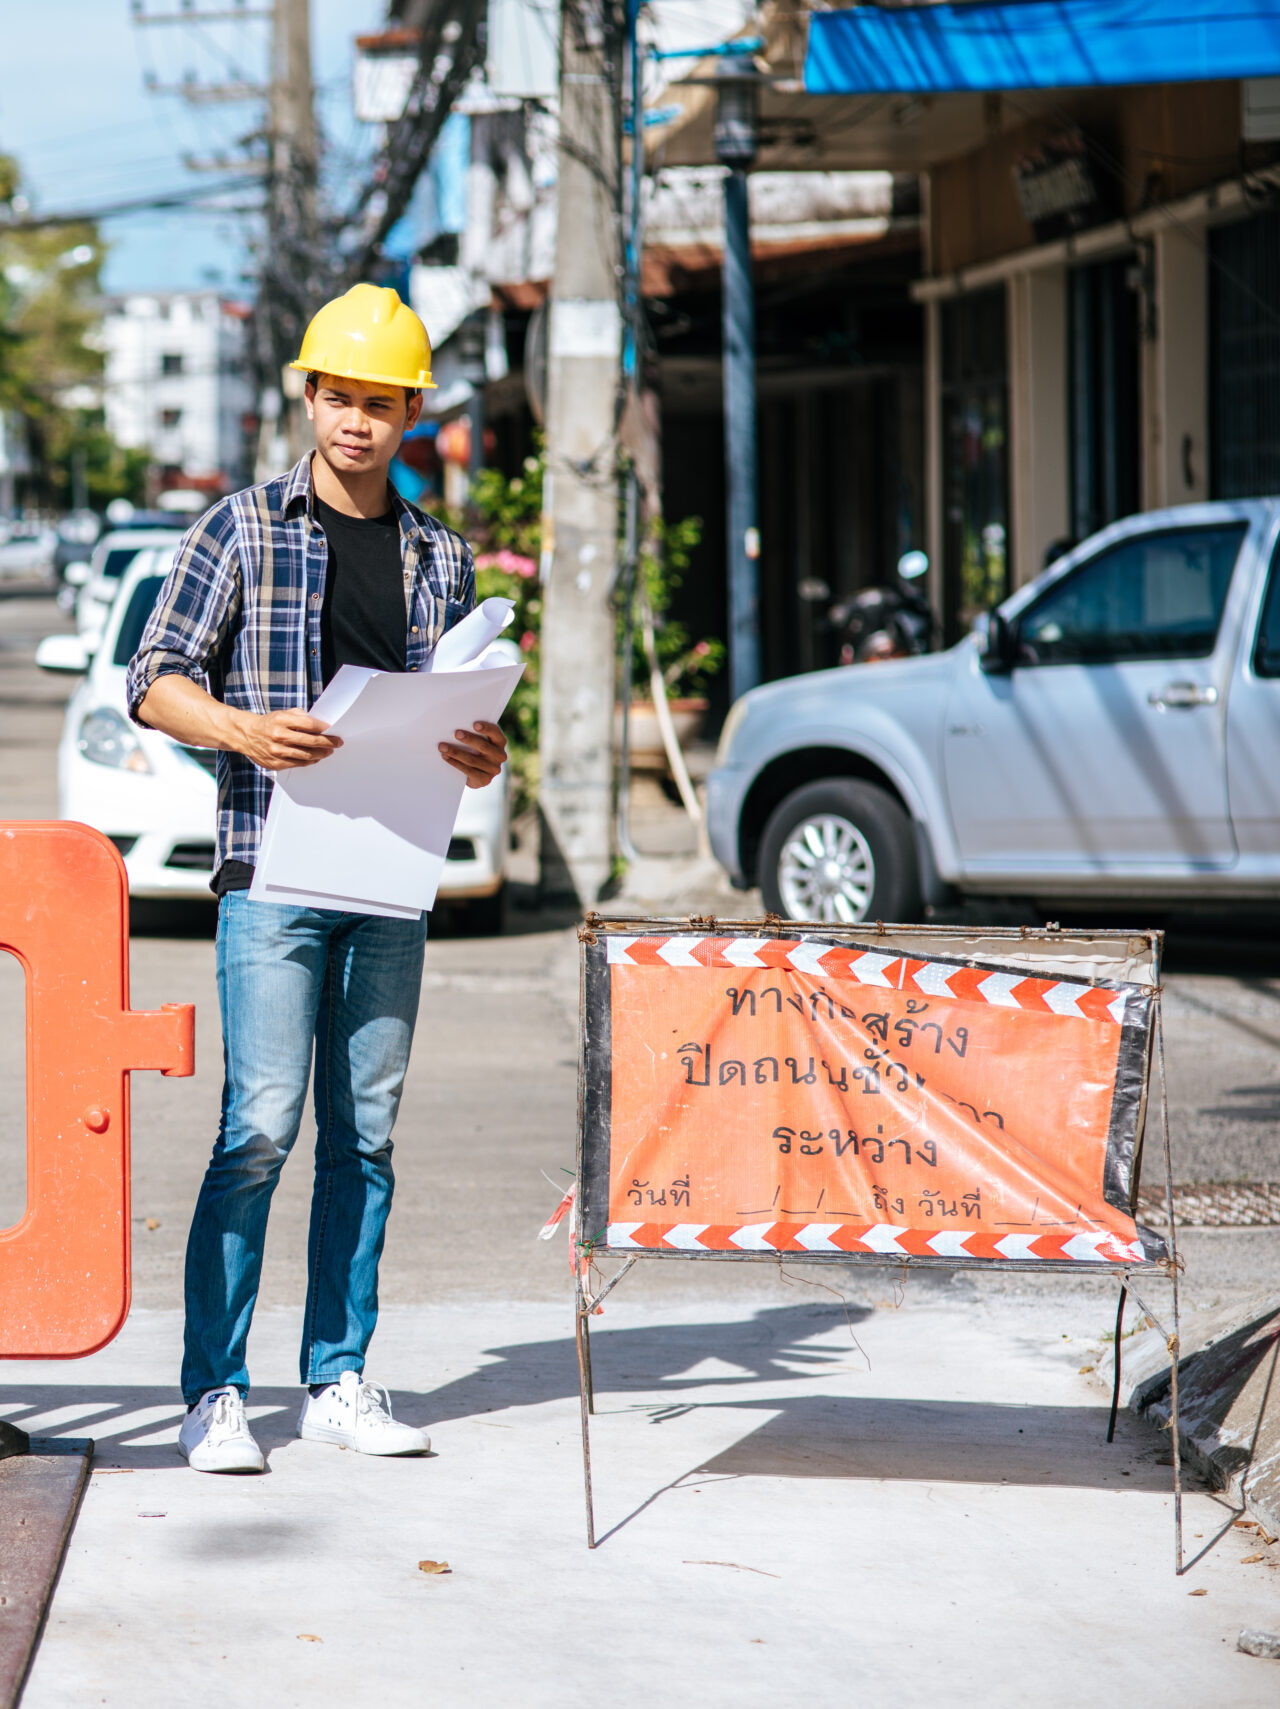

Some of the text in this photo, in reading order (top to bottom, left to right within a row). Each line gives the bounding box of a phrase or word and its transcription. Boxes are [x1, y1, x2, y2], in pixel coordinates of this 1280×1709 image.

[772, 1124, 938, 1167] ระหว่าง
[627, 1174, 691, 1207] วันที่
[918, 1187, 982, 1220] วันที่
